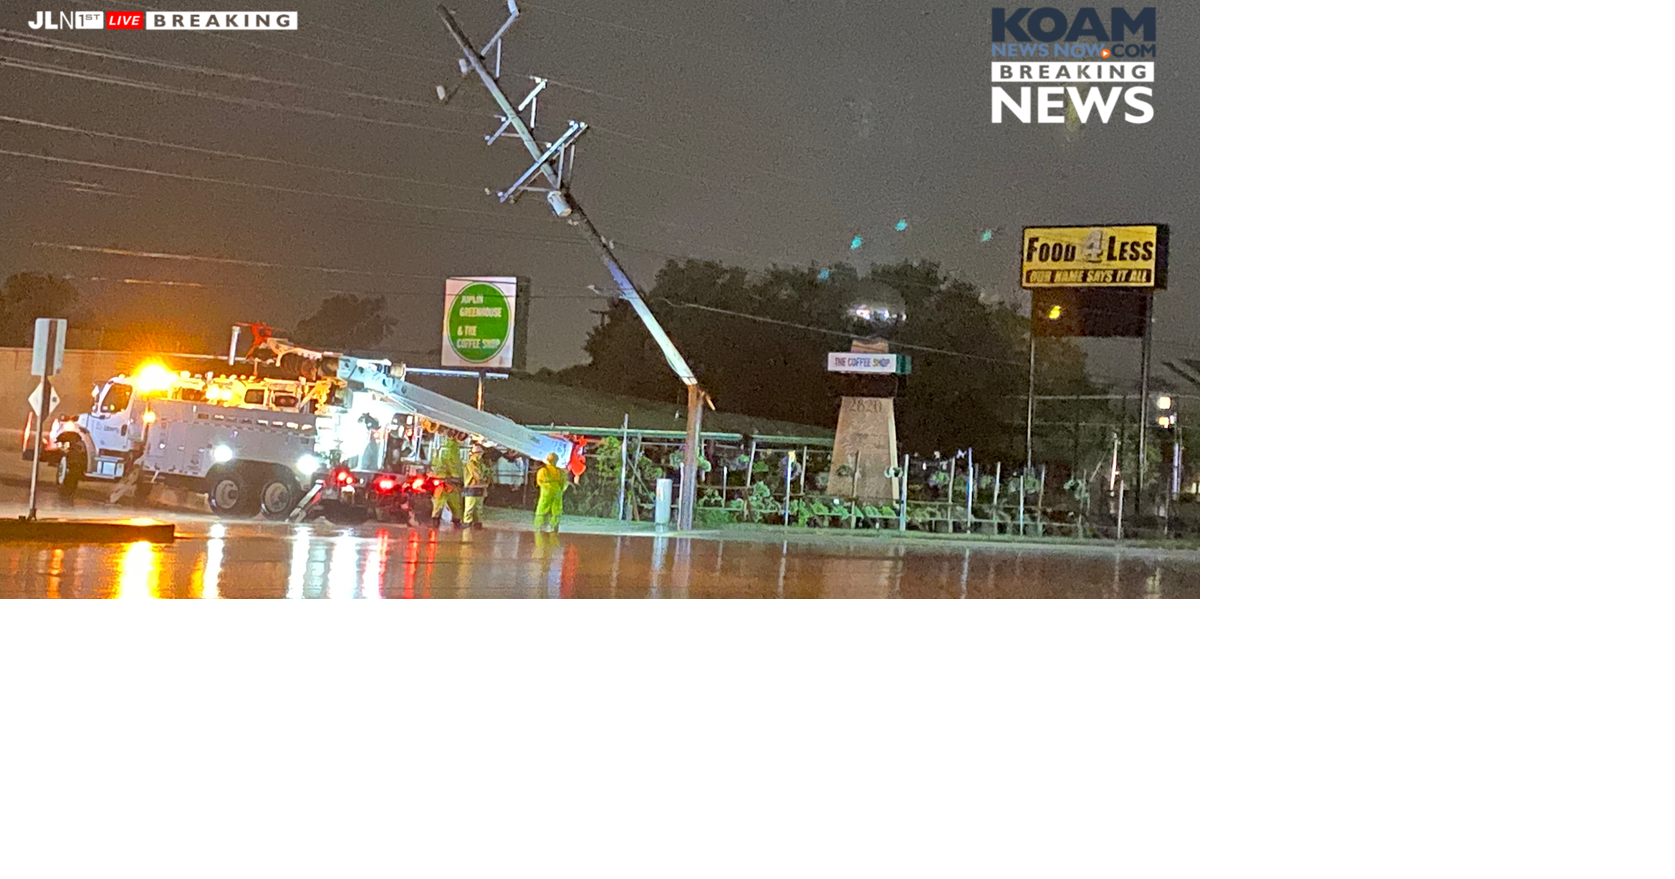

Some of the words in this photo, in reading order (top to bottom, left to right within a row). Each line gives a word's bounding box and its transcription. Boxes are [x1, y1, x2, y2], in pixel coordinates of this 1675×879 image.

[1084, 229, 1104, 263] 4
[1054, 270, 1084, 283] NAME
[1086, 269, 1113, 282] SAYS
[1116, 269, 1127, 282] IT
[1130, 269, 1147, 282] ALL
[464, 325, 477, 336] THE
[456, 338, 480, 348] COFFEE
[835, 357, 846, 367] THE
[847, 357, 871, 368] COFFEE
[872, 358, 890, 368] SHOP
